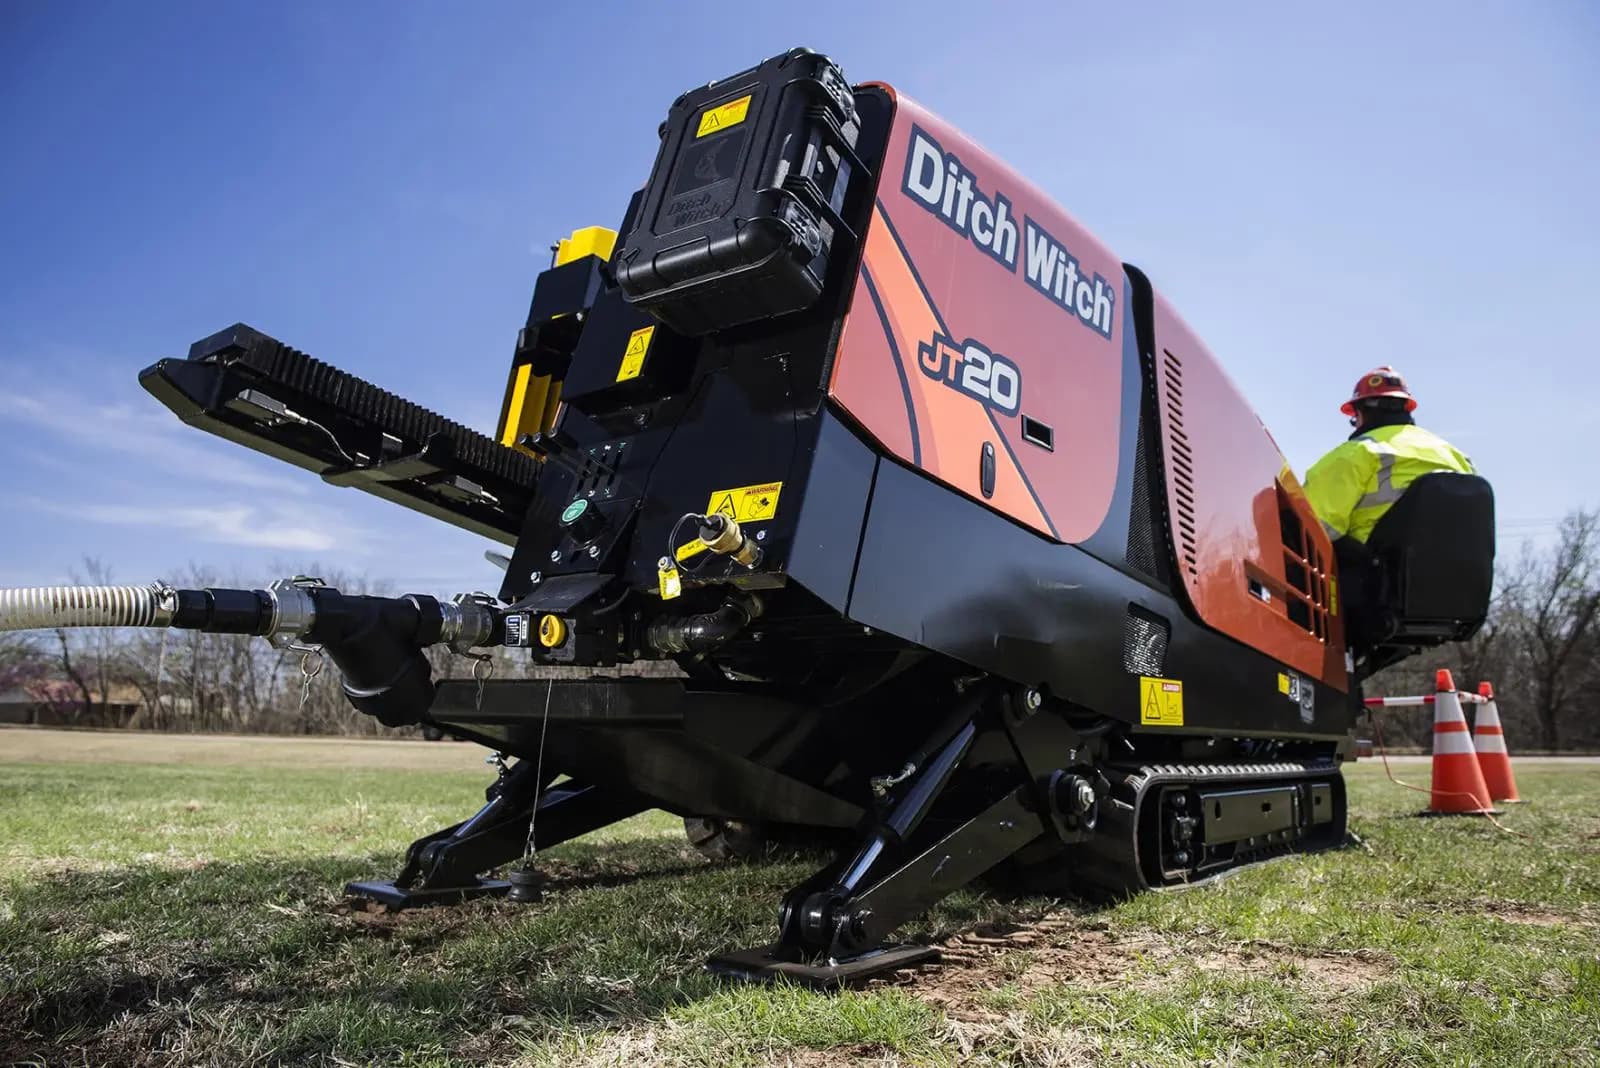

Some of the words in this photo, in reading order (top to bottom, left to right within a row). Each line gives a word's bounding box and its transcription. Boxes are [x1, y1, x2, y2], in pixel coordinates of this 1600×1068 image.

[667, 192, 711, 216] Ditch
[907, 134, 1018, 264] Ditch
[1026, 224, 1112, 333] Witch
[921, 341, 1019, 410] JT20
